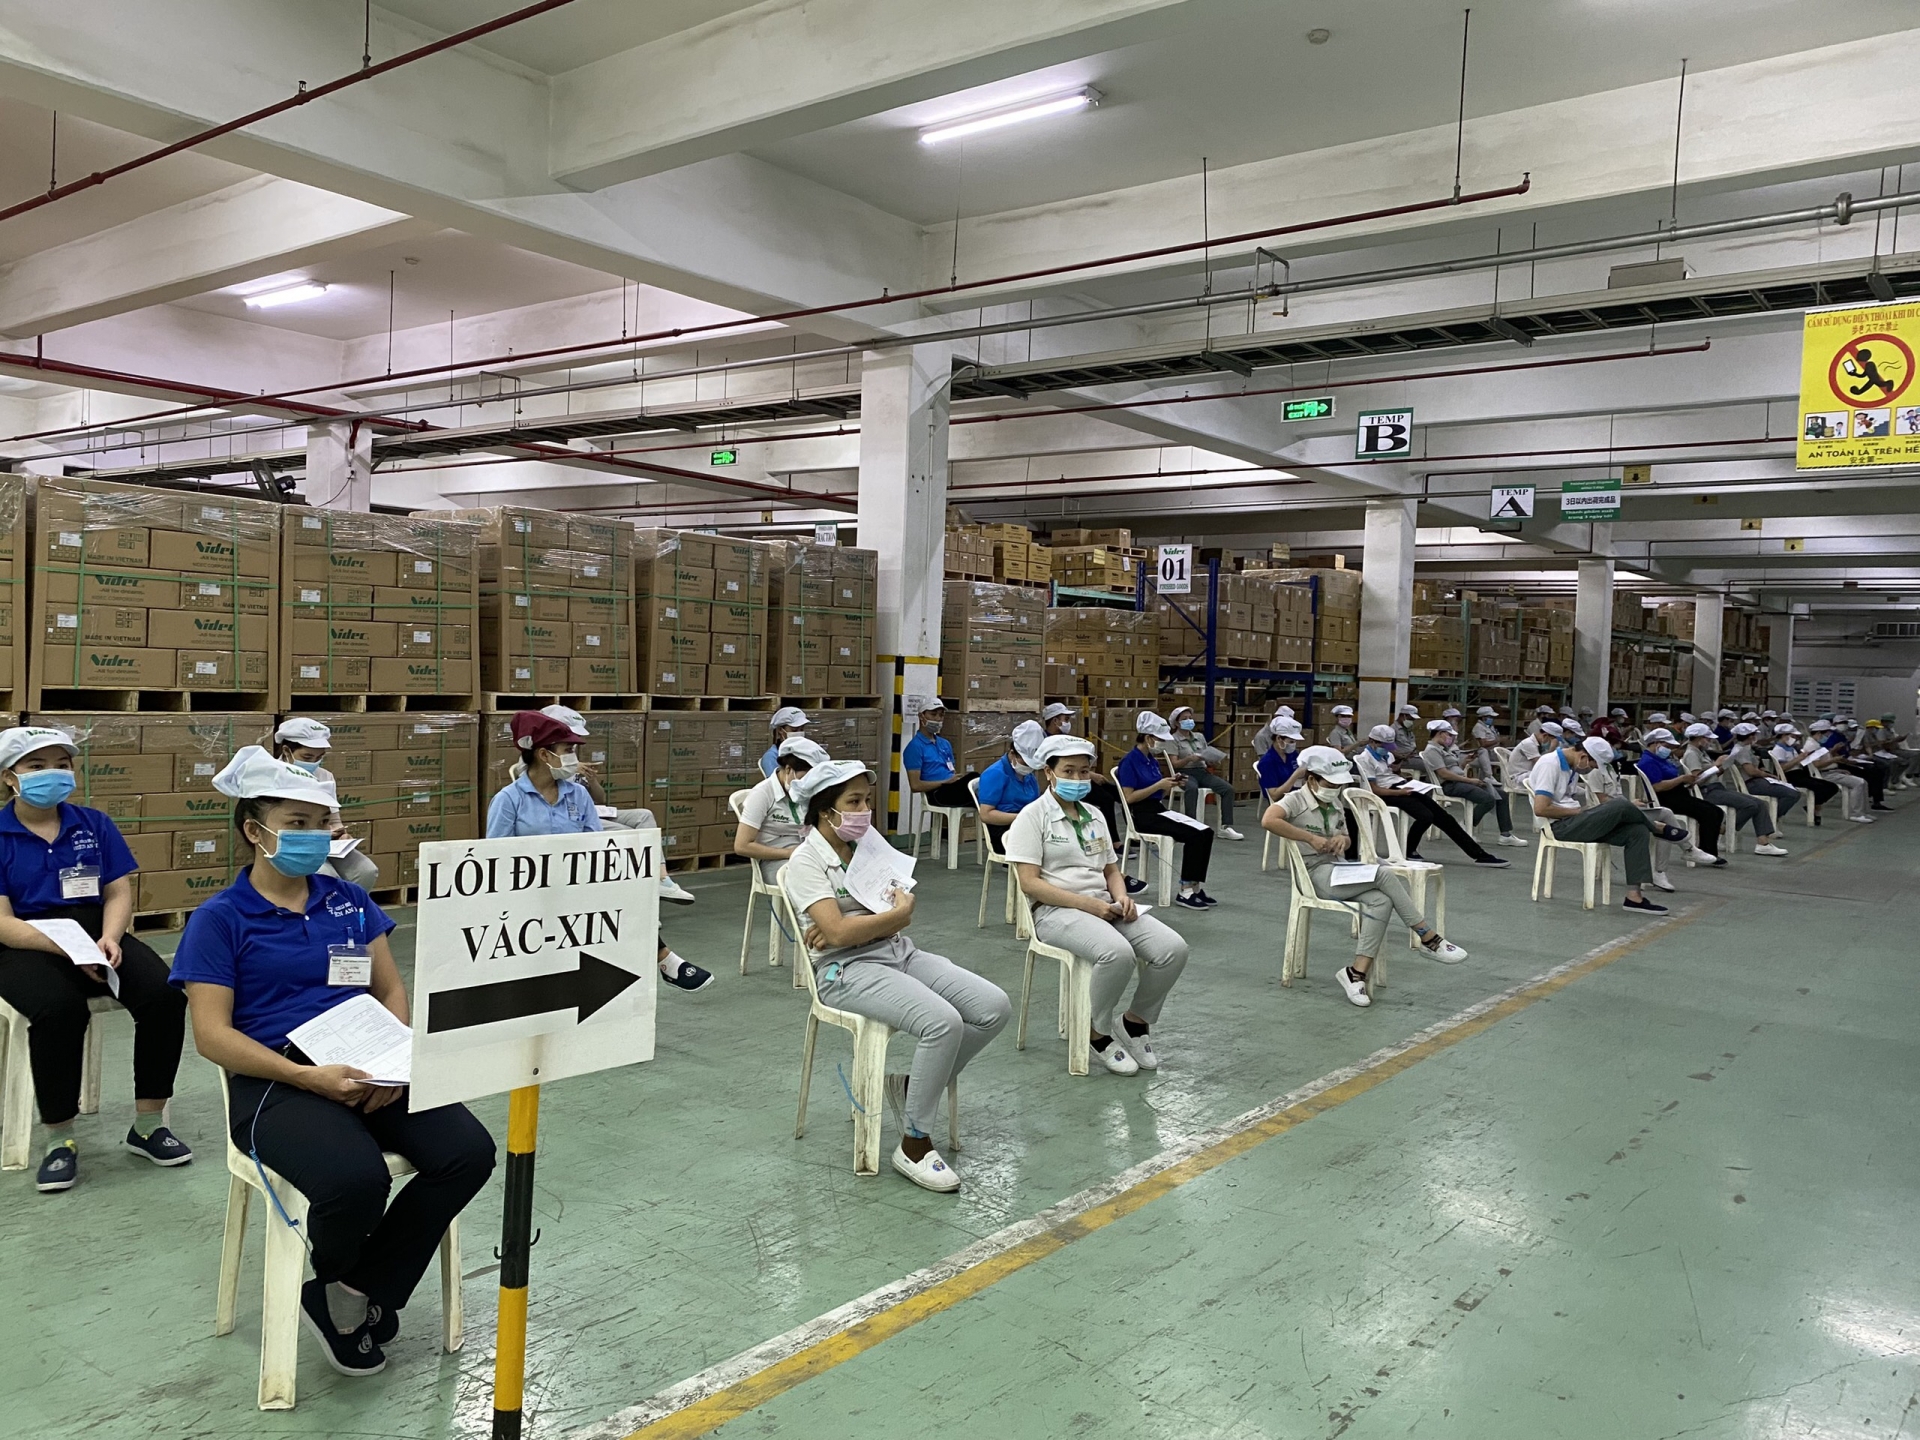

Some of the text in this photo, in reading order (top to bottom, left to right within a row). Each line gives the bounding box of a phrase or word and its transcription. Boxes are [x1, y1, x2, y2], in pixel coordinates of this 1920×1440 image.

[1893, 309, 1906, 319] KHI
[1369, 415, 1404, 425] TEMP
[1358, 424, 1408, 453] B
[1874, 446, 1901, 455] TRÊN
[1492, 496, 1531, 517] A
[1162, 558, 1187, 581] 01
[331, 628, 366, 640] Nidec
[90, 654, 135, 666] Nidec
[186, 800, 227, 811] Nidec
[426, 838, 653, 900] LỐI ĐI TIÊM
[186, 876, 226, 888] Nidec
[461, 909, 623, 962] VẮC-XIN
